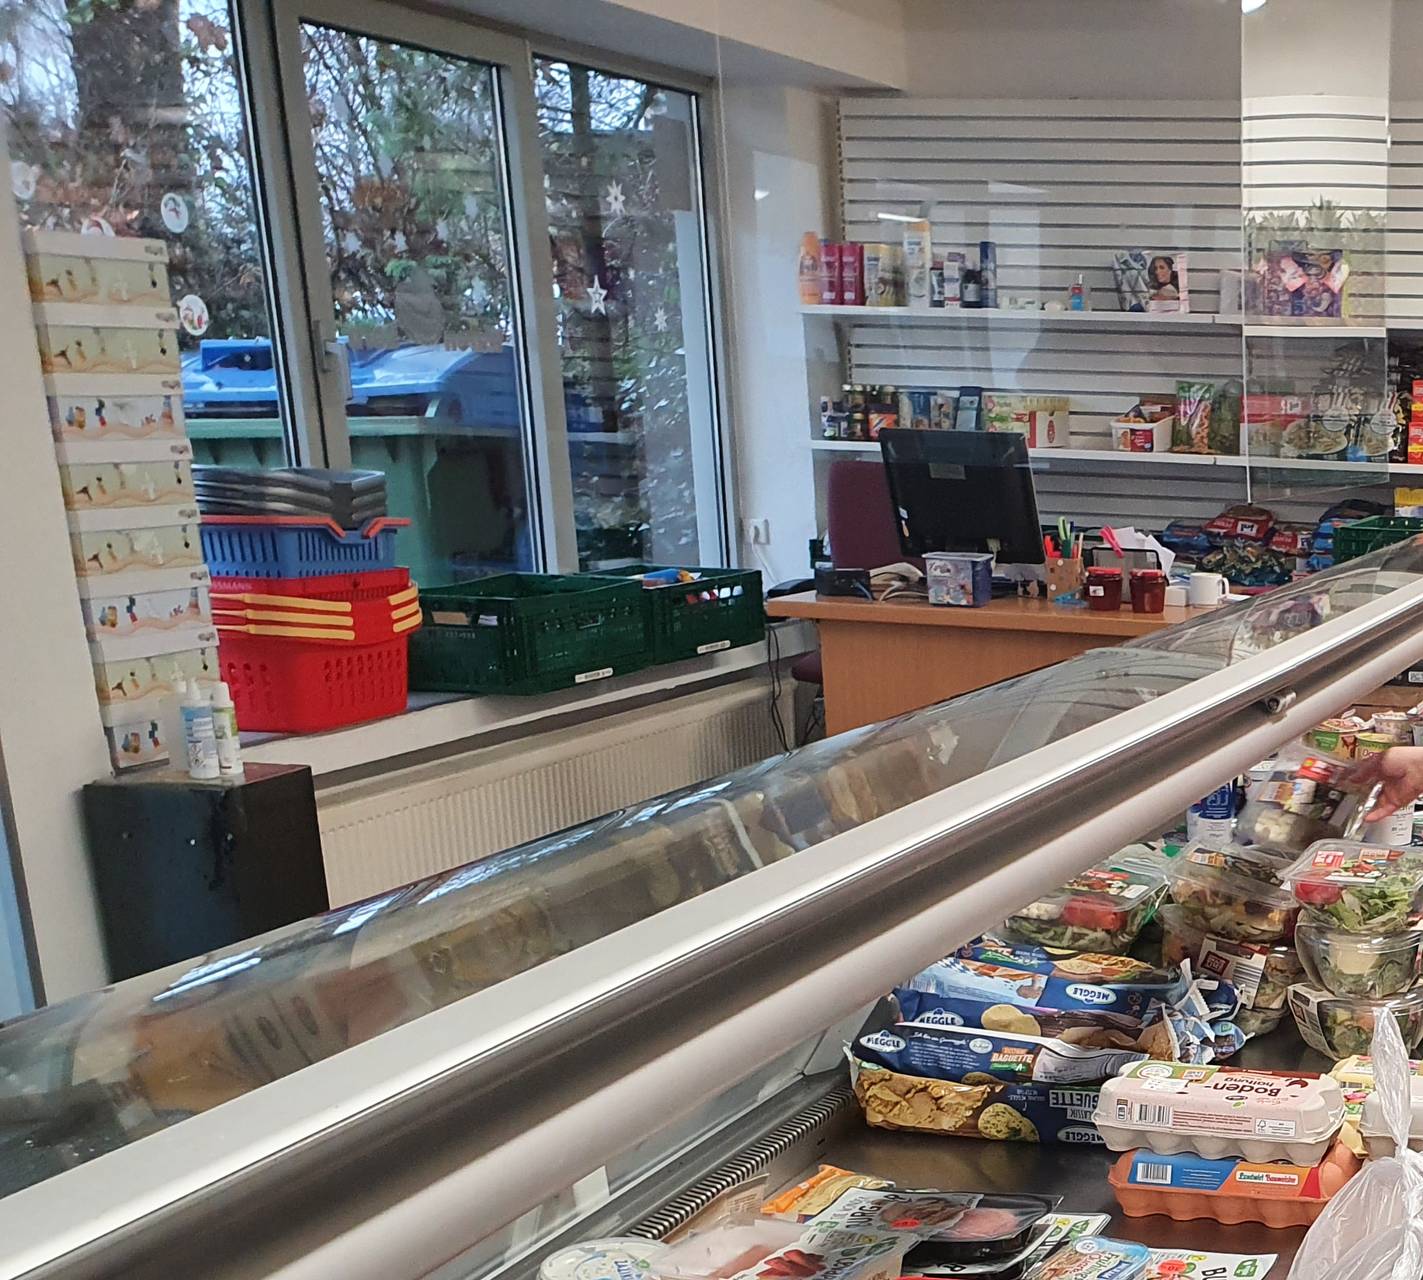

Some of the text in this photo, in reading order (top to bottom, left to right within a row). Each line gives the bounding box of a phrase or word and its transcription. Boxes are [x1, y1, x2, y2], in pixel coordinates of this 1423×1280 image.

[1072, 987, 1110, 1001] MEGGLE
[919, 1016, 956, 1025] MEGGLE
[866, 1036, 901, 1049] MEGGLE
[990, 1053, 1034, 1064] BAGUETTE
[1224, 1077, 1275, 1087] haltung
[1205, 1082, 1281, 1097] Boden-
[1051, 1092, 1099, 1109] GUETTE
[1065, 1131, 1104, 1142] MEGGLE
